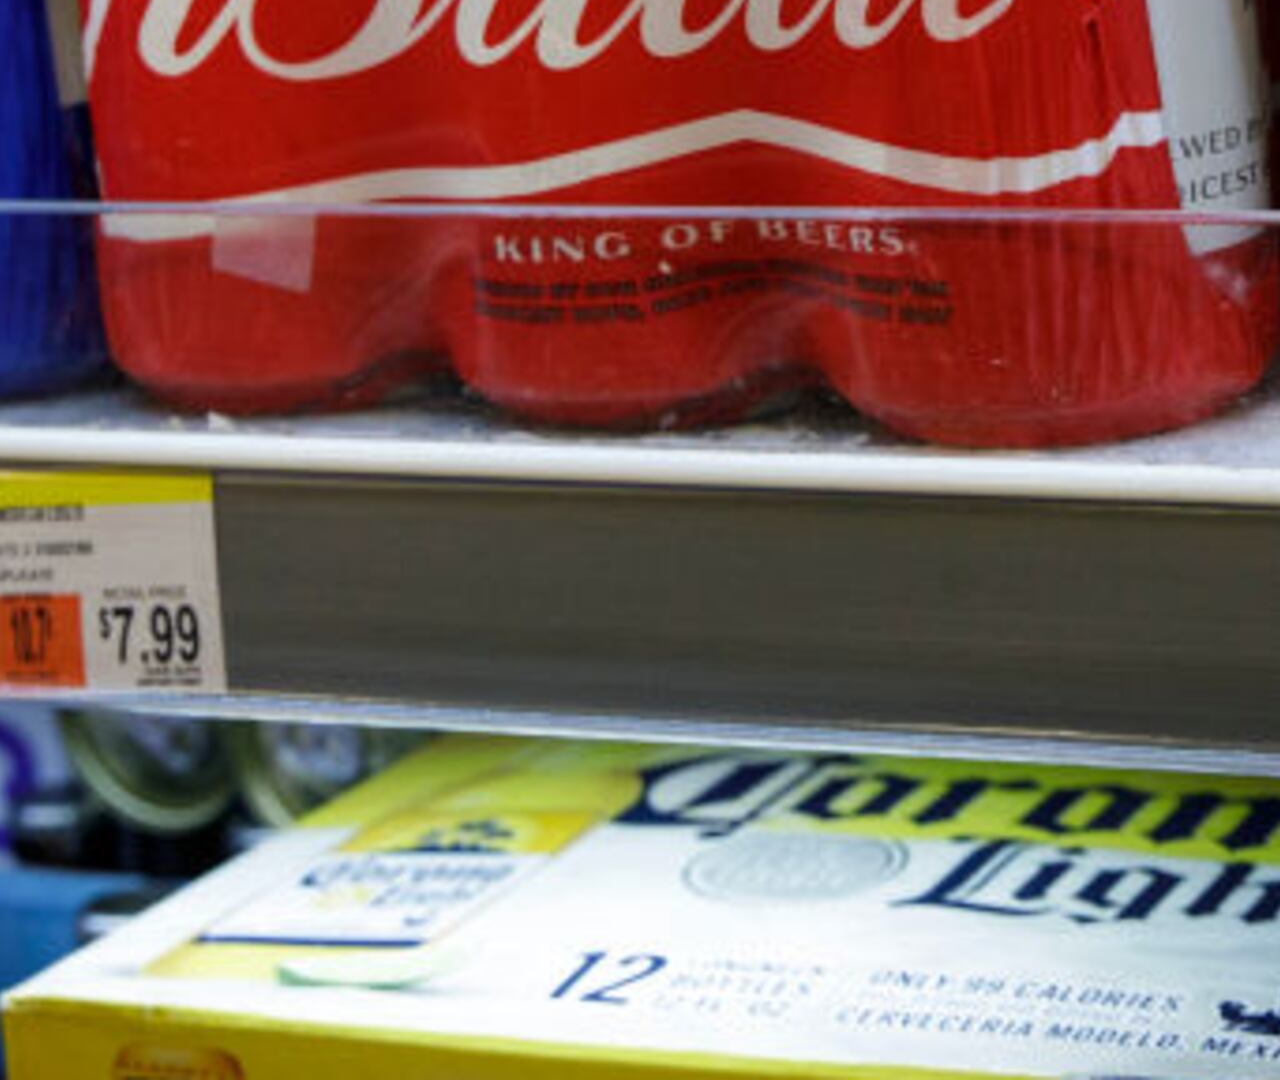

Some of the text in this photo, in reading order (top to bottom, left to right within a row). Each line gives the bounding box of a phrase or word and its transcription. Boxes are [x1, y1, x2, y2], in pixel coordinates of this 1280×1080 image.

[493, 230, 631, 266] KING
[661, 220, 733, 249] OF
[98, 603, 201, 665] $7.99
[548, 949, 669, 1006] 12
[1012, 980, 1186, 1016] CALORIES
[834, 1005, 1033, 1040] CERVECERIA
